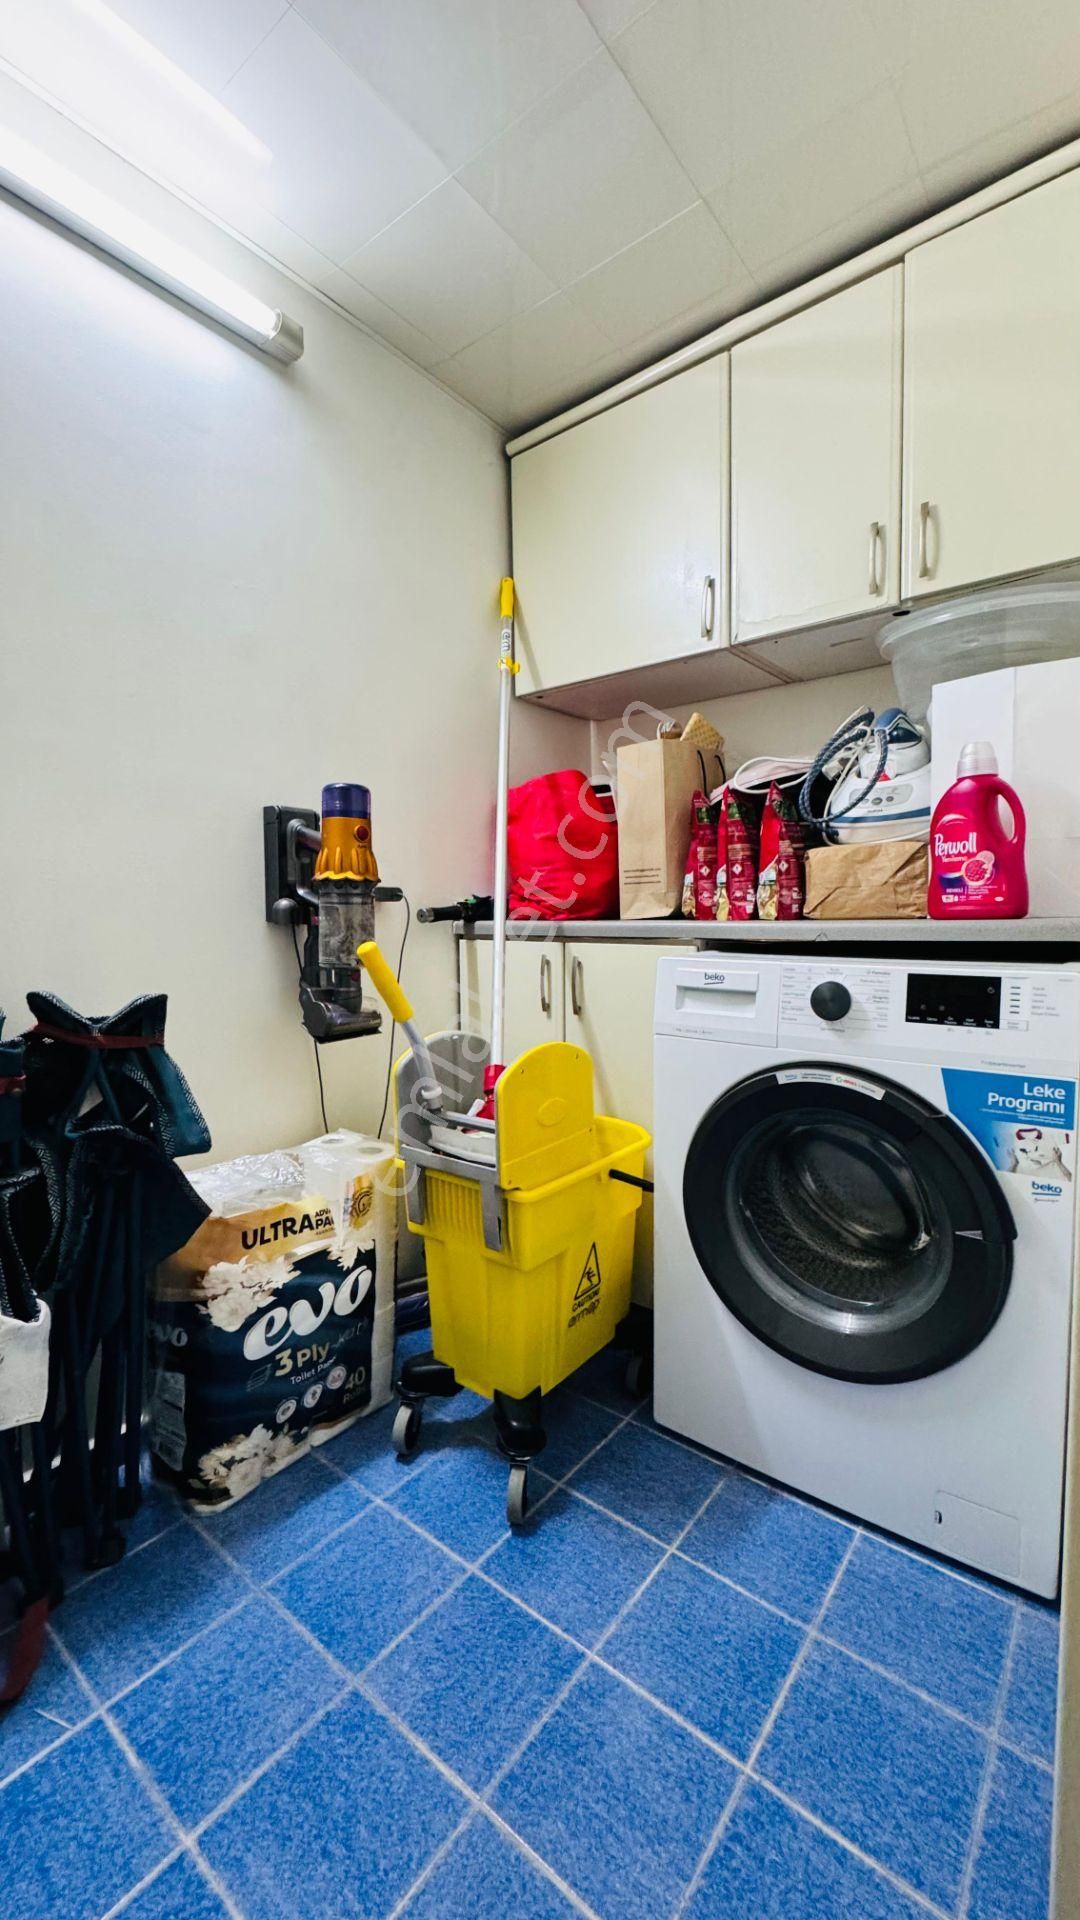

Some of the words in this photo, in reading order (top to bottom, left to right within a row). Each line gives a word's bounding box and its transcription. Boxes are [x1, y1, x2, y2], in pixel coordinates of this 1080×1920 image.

[934, 832, 977, 857] Perwoll
[704, 972, 725, 984] beko
[1023, 1082, 1066, 1100] Leke
[987, 1092, 1065, 1114] Programı
[1031, 1180, 1063, 1196] beko
[241, 1213, 315, 1250] ULTRA
[243, 1265, 373, 1361] evo
[274, 1348, 294, 1377] 3
[296, 1342, 330, 1369] Ply
[289, 1369, 316, 1385] Toilet
